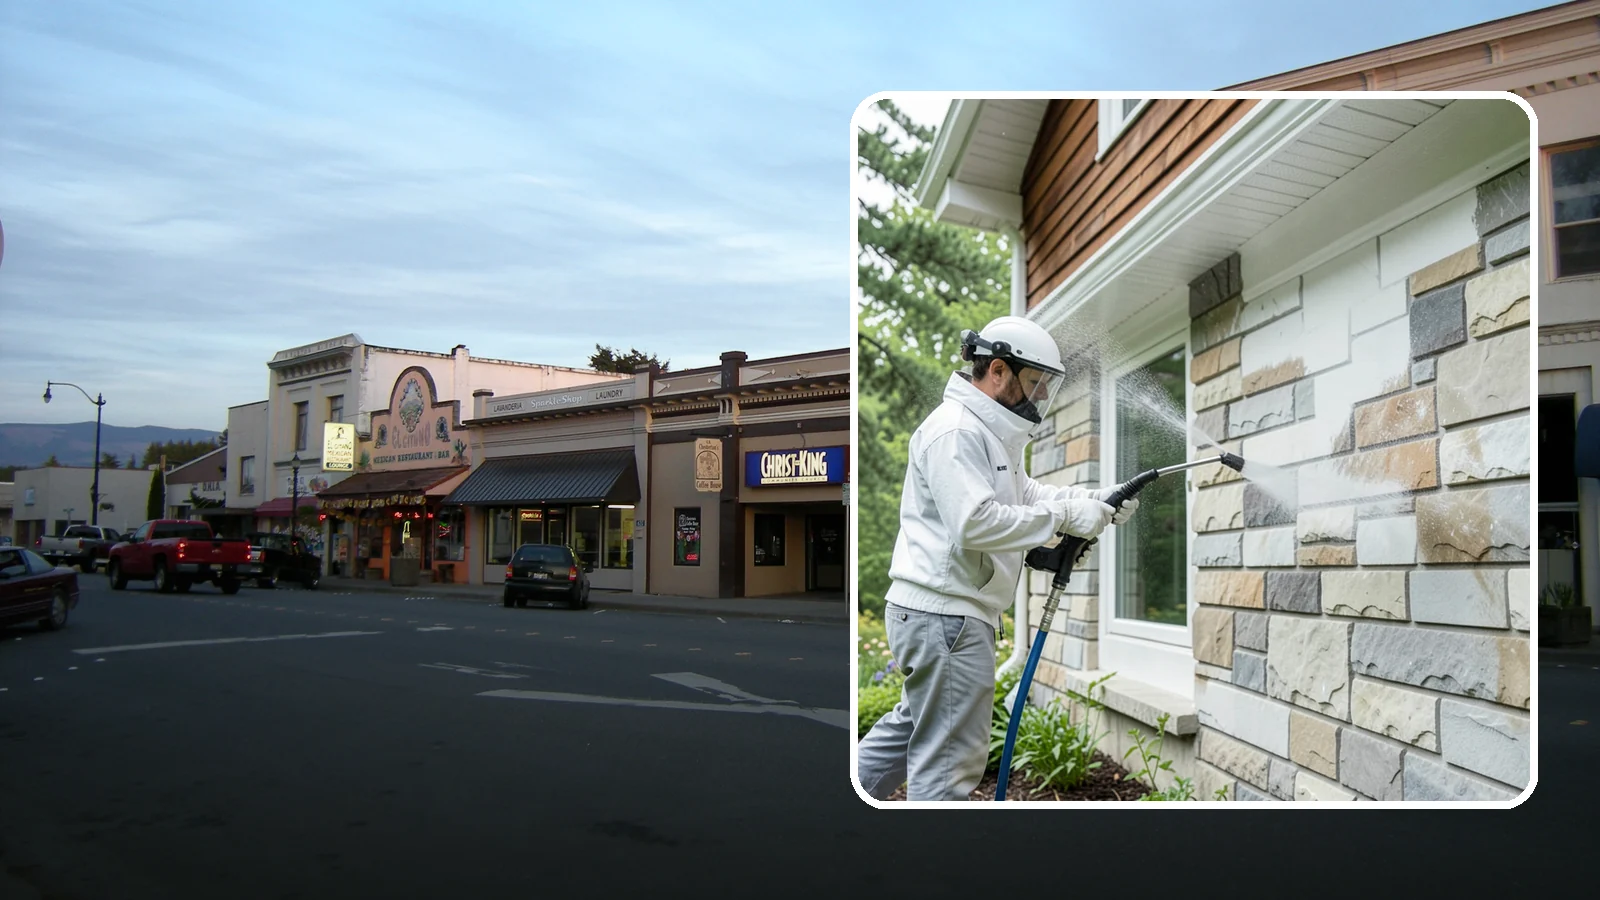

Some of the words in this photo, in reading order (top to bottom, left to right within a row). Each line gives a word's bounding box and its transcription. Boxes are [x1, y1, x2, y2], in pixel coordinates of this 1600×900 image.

[595, 389, 624, 400] LAUNDRY
[530, 397, 560, 408] Sparkle
[562, 394, 583, 404] Shop
[493, 402, 523, 413] LAVANDERIA
[373, 455, 396, 464] MEXICAN
[397, 451, 433, 462] RESTAURANT
[437, 450, 450, 459] BAR
[799, 450, 828, 476] KING
[697, 480, 709, 488] Coffee
[710, 480, 721, 488] House
